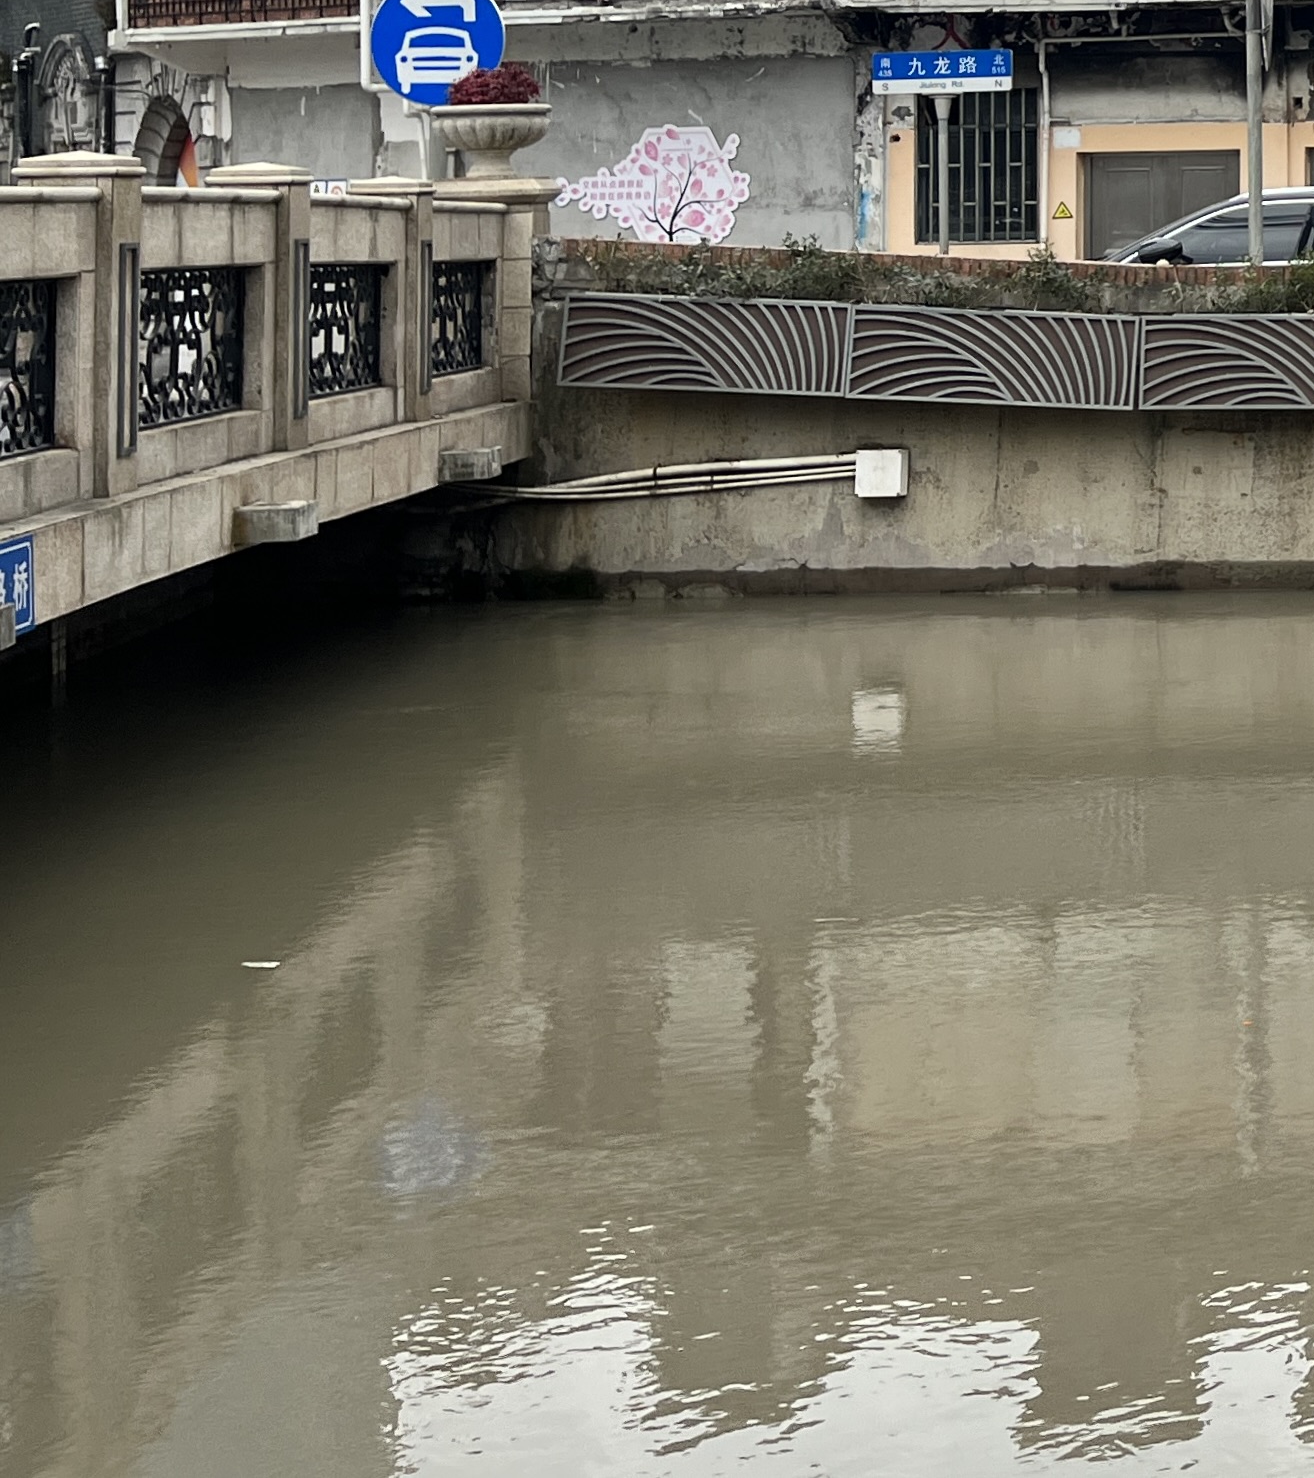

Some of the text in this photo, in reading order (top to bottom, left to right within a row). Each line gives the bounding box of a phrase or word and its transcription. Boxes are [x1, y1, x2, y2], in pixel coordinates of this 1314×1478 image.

[880, 57, 891, 68] 南
[993, 54, 1005, 65] 北
[907, 56, 977, 76] 九龙路
[881, 82, 889, 92] S
[994, 79, 1003, 88] N
